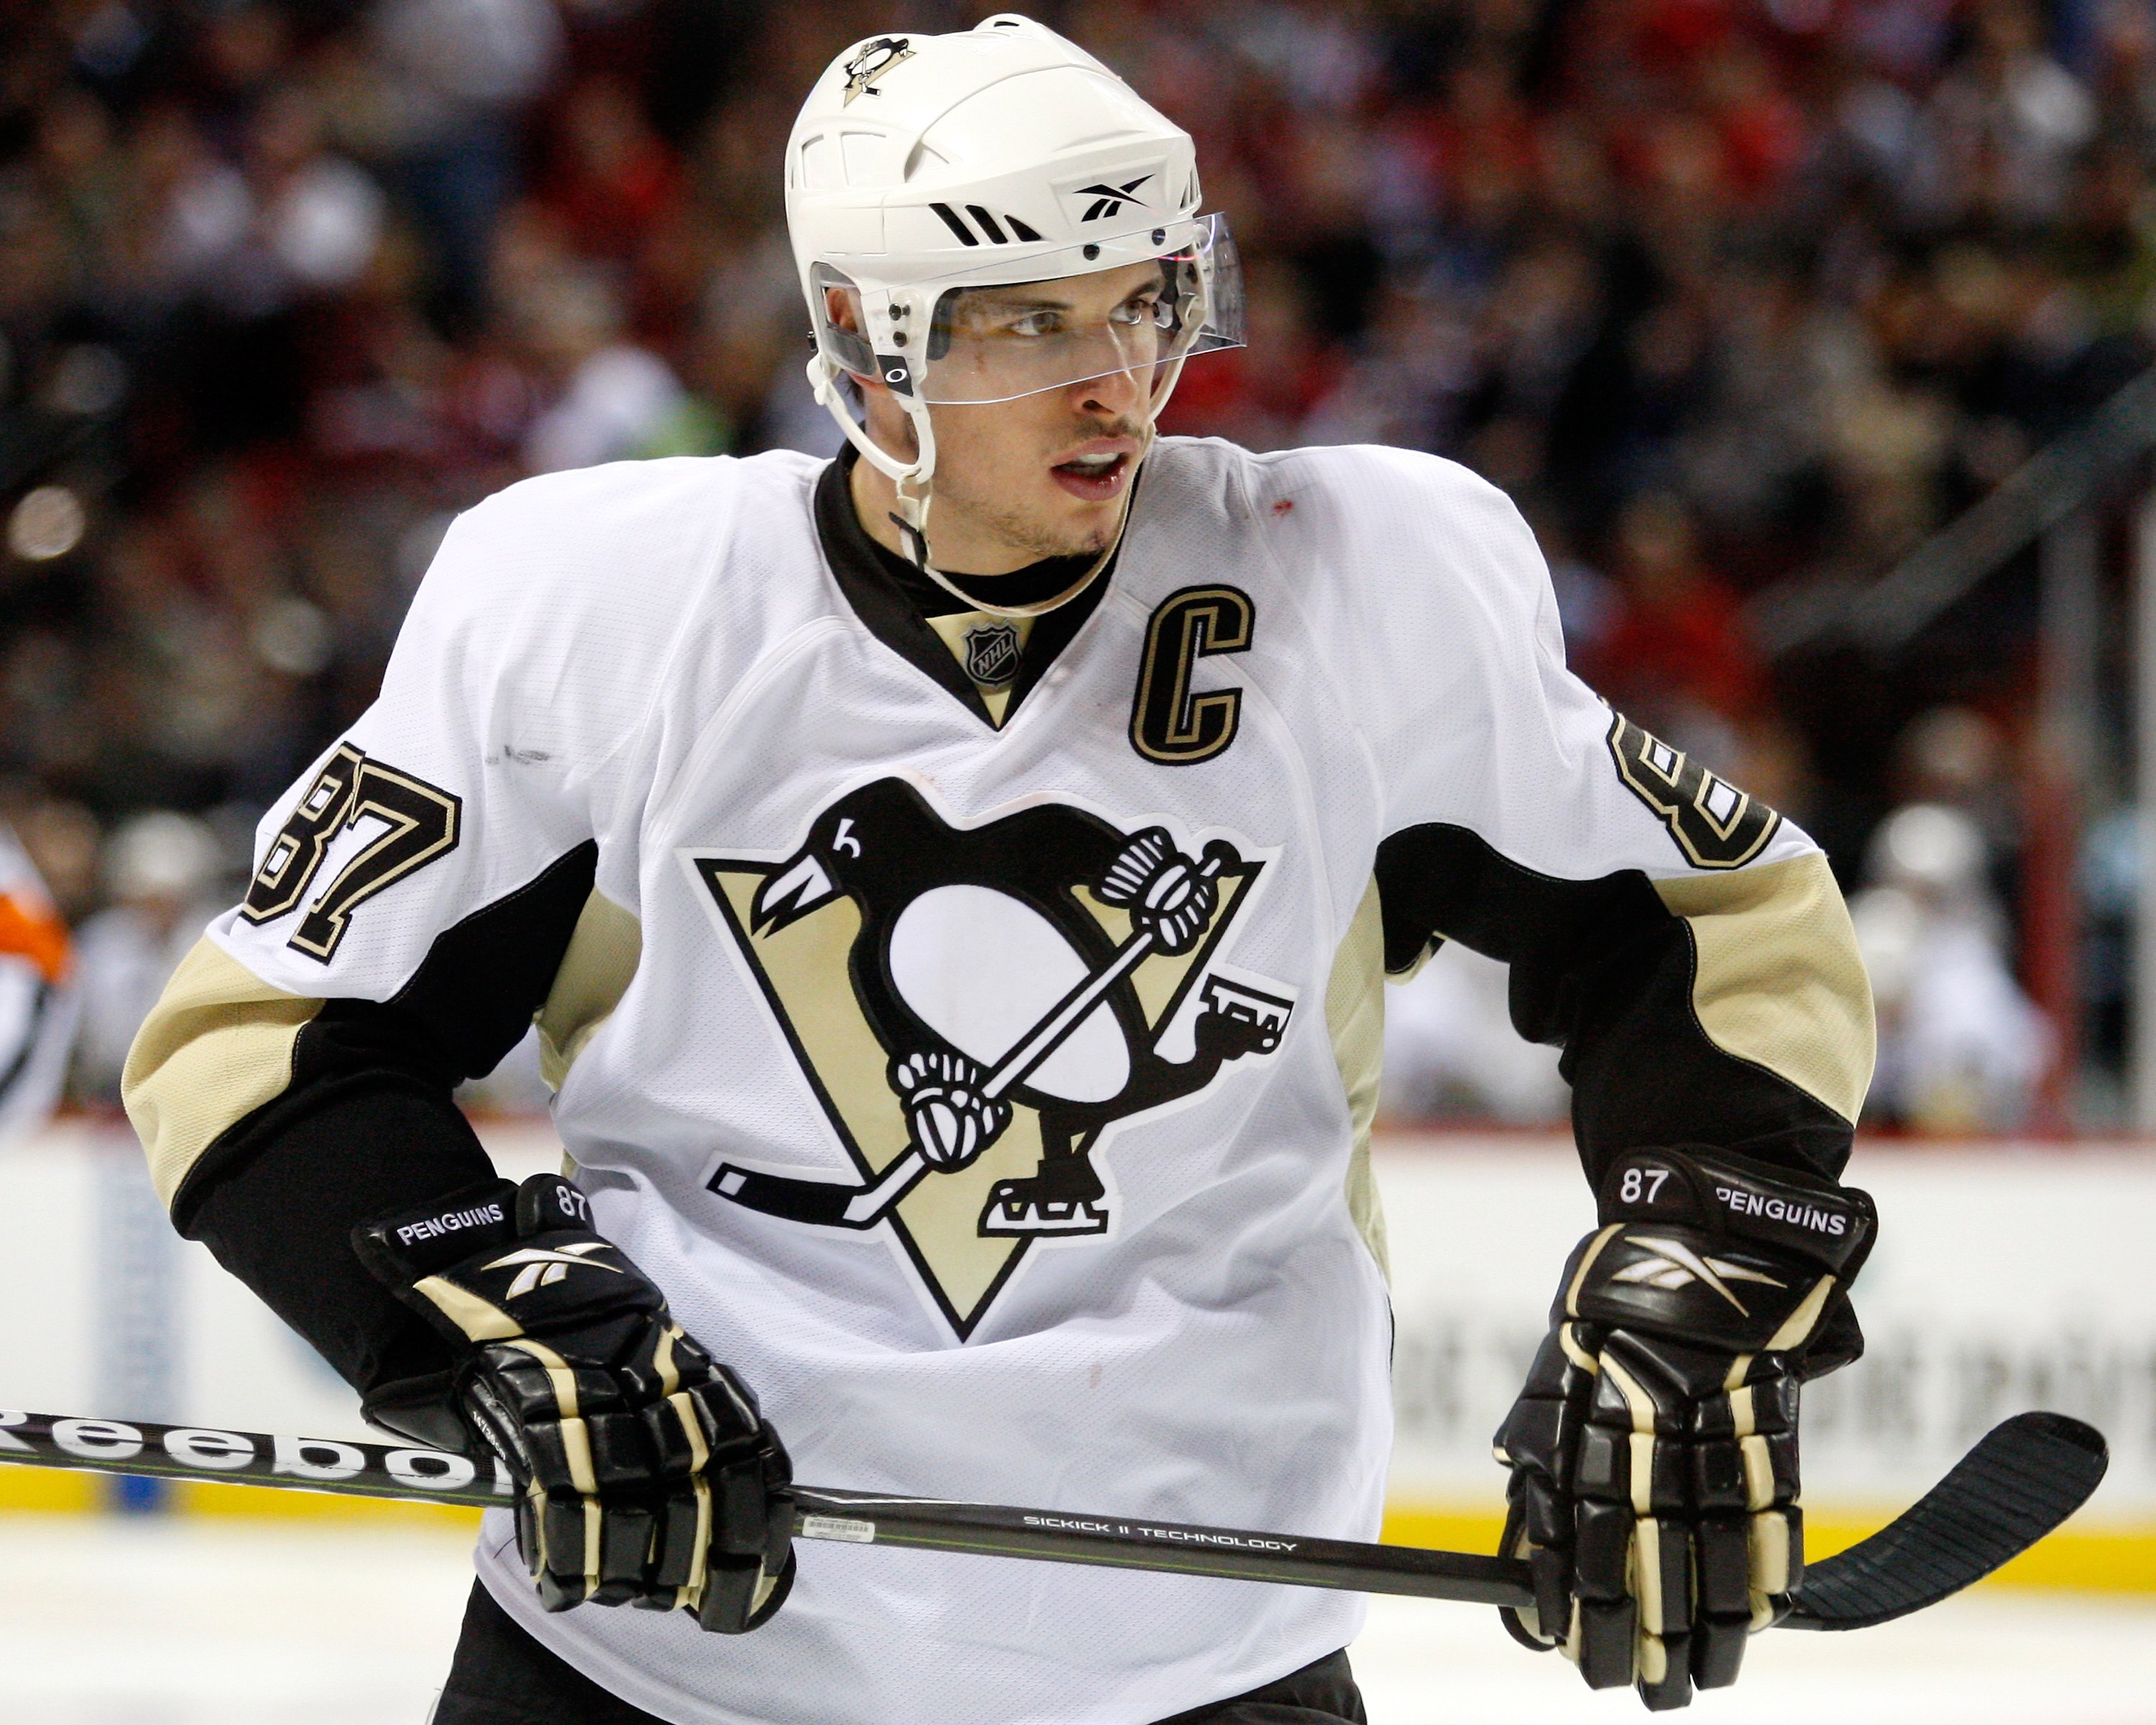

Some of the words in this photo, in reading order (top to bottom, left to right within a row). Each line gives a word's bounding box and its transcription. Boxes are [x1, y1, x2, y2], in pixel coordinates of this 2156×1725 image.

[977, 640, 1010, 677] NHL
[1128, 584, 1256, 767] C
[239, 740, 463, 966] 87
[556, 1185, 586, 1221] 87
[1620, 1168, 1669, 1204] 87
[397, 1203, 504, 1246] PENGUINS
[1715, 1186, 1847, 1236] PENGUINS
[0, 1409, 514, 1496] eebo
[1023, 1516, 1110, 1532] SICKICK
[1119, 1525, 1129, 1535] II
[1138, 1527, 1298, 1552] TECHNOLOGY
